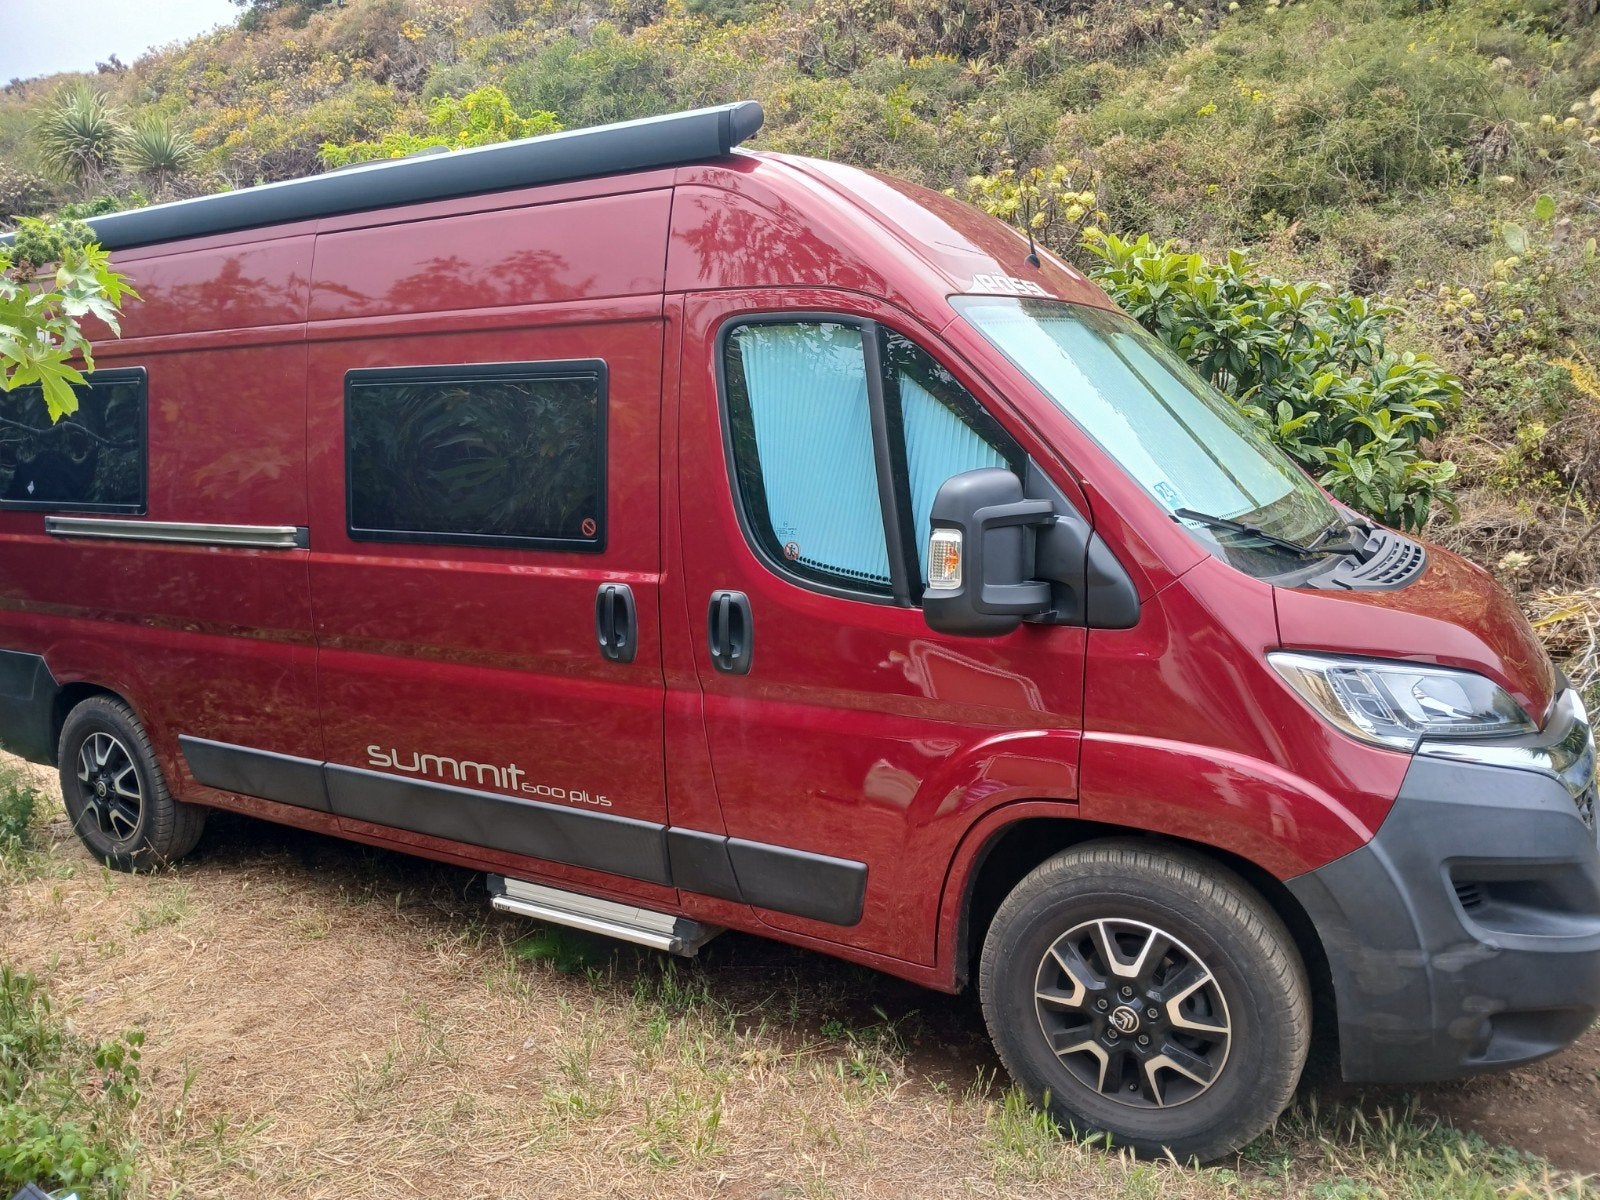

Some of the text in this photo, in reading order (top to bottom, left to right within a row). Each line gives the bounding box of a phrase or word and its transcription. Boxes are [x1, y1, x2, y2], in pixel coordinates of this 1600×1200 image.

[973, 271, 1059, 299] PÖSSL
[367, 745, 613, 807] summit 600 plus
